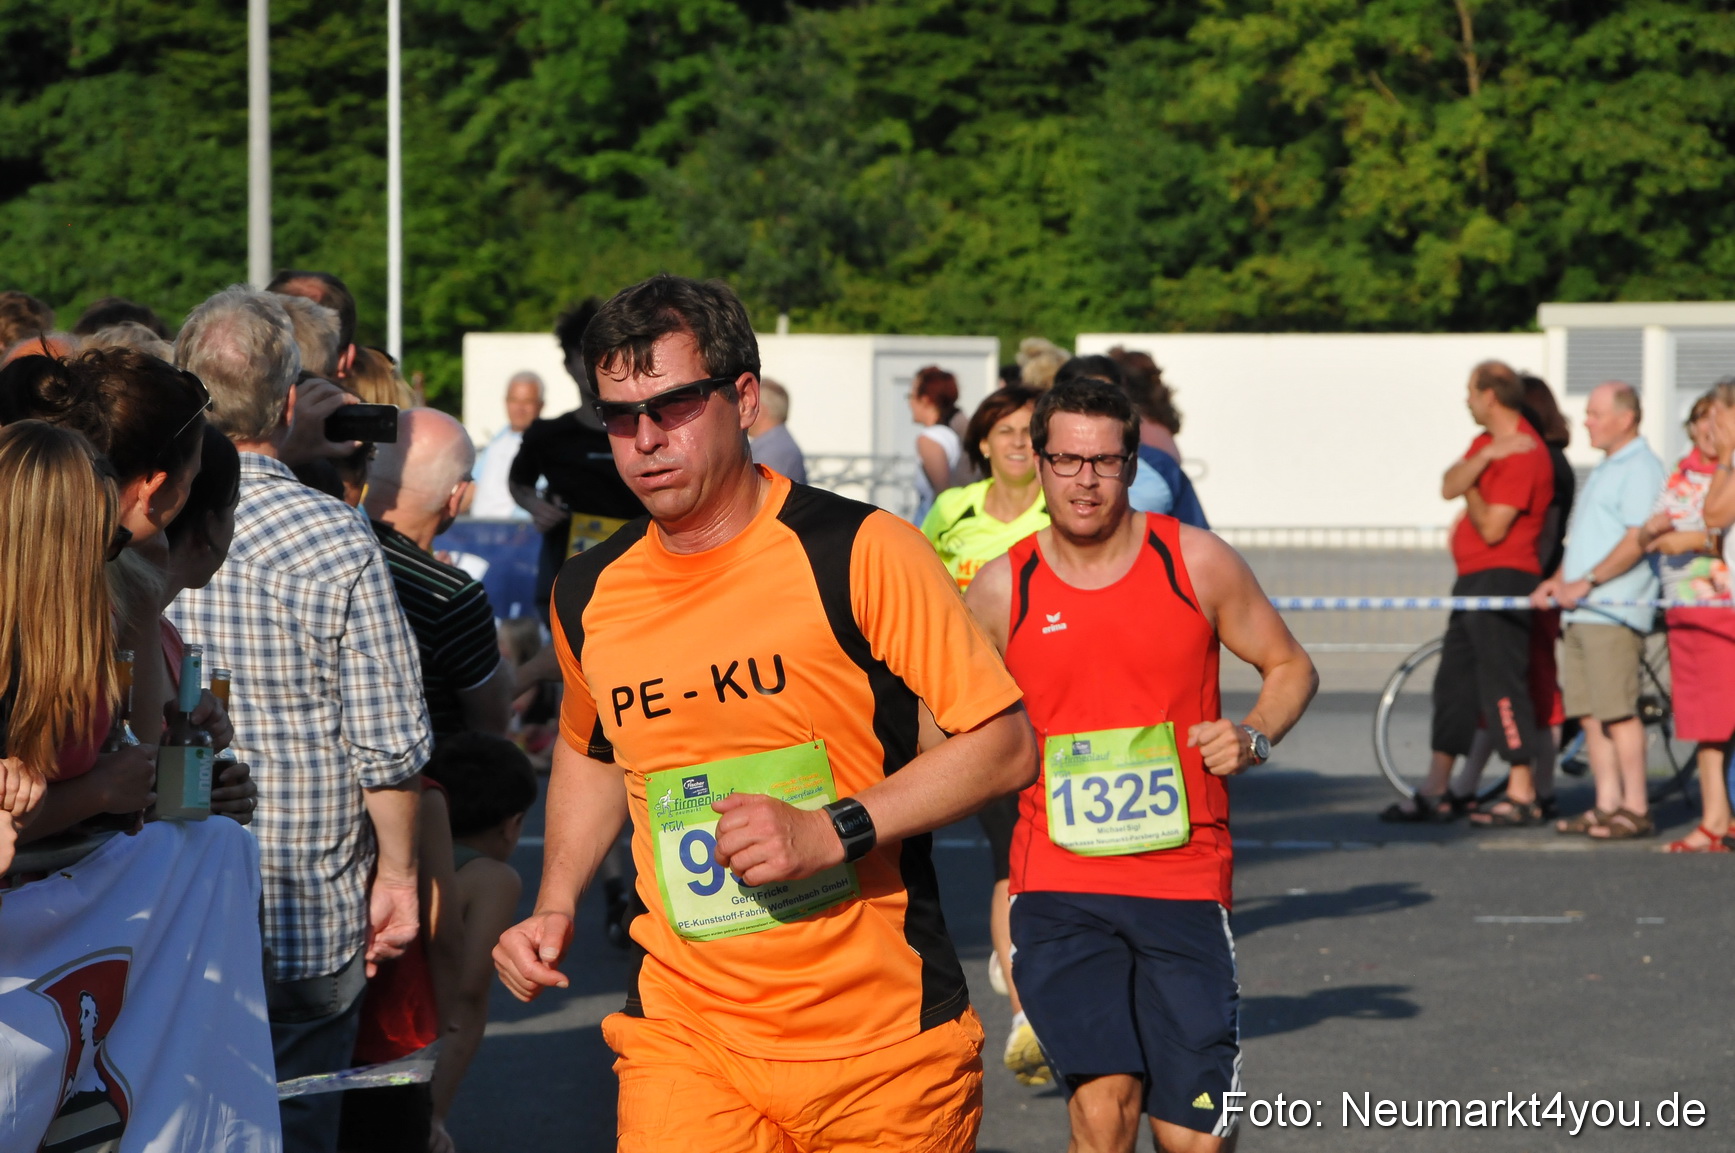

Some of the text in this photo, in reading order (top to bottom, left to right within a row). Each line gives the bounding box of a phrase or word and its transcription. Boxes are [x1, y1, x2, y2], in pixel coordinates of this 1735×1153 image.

[1052, 767, 1179, 827] 1325
[1097, 823, 1141, 834] Michael Sigl
[677, 907, 768, 930] PE-Kunststoff-Fabrik
[768, 889, 820, 911] Woffenbach
[821, 878, 849, 894] GmbH
[731, 884, 789, 905] Gerd Fricke
